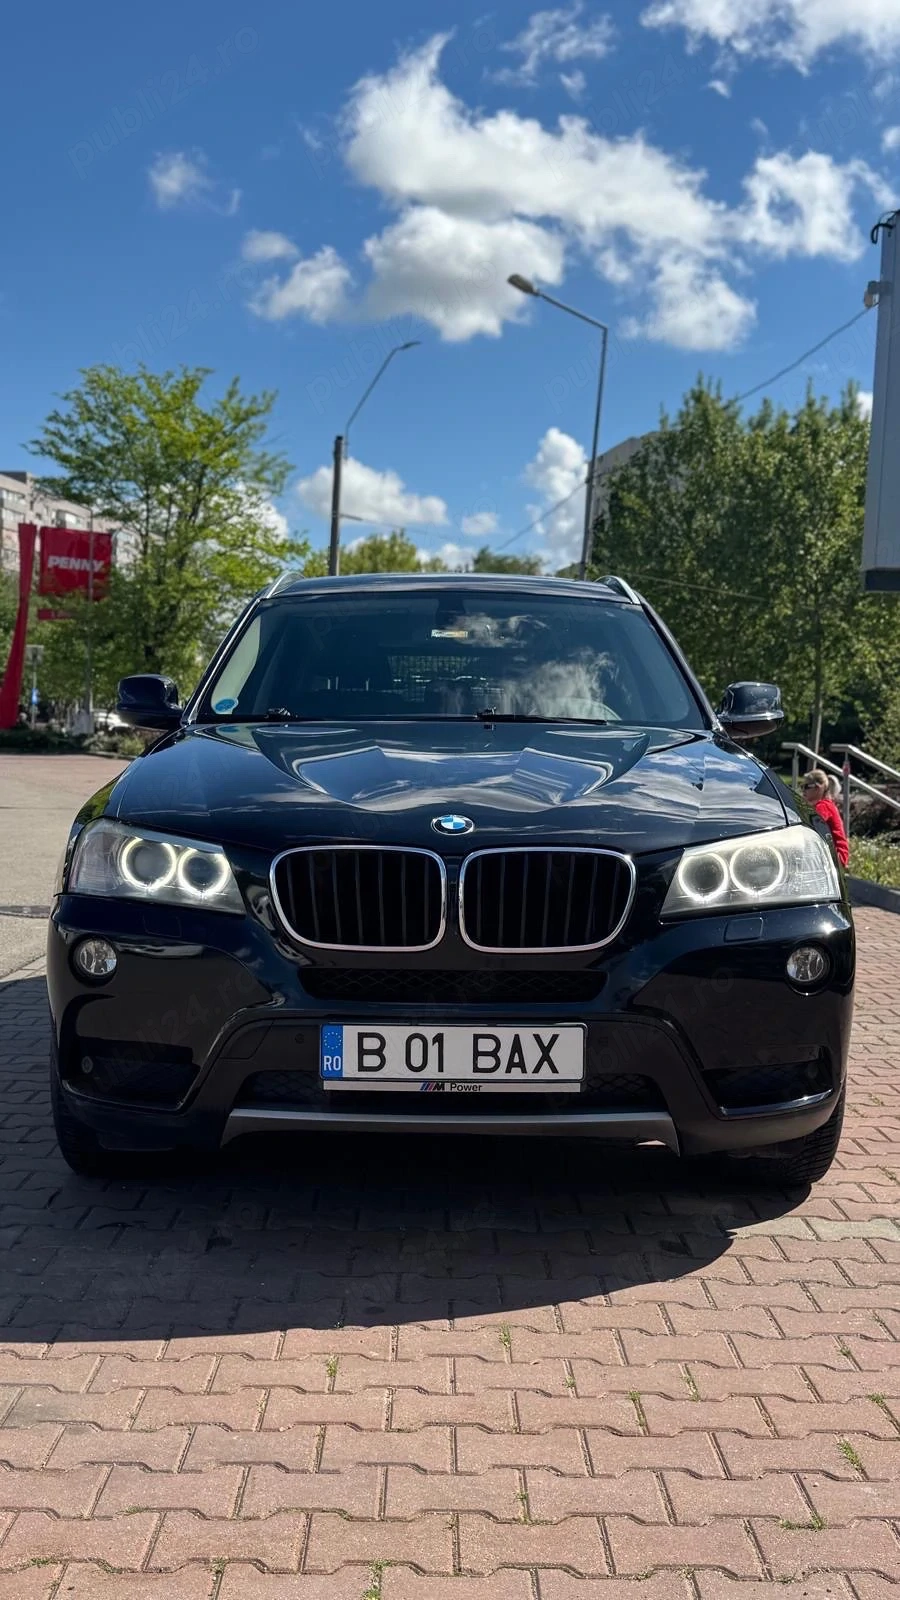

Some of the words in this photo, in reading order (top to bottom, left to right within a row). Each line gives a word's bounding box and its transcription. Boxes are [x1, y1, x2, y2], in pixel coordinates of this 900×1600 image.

[48, 555, 104, 572] PENNY
[357, 1032, 387, 1073] B
[405, 1033, 444, 1073] 01
[472, 1033, 560, 1074] BAX
[323, 1056, 341, 1071] RO
[450, 1083, 483, 1092] Power
